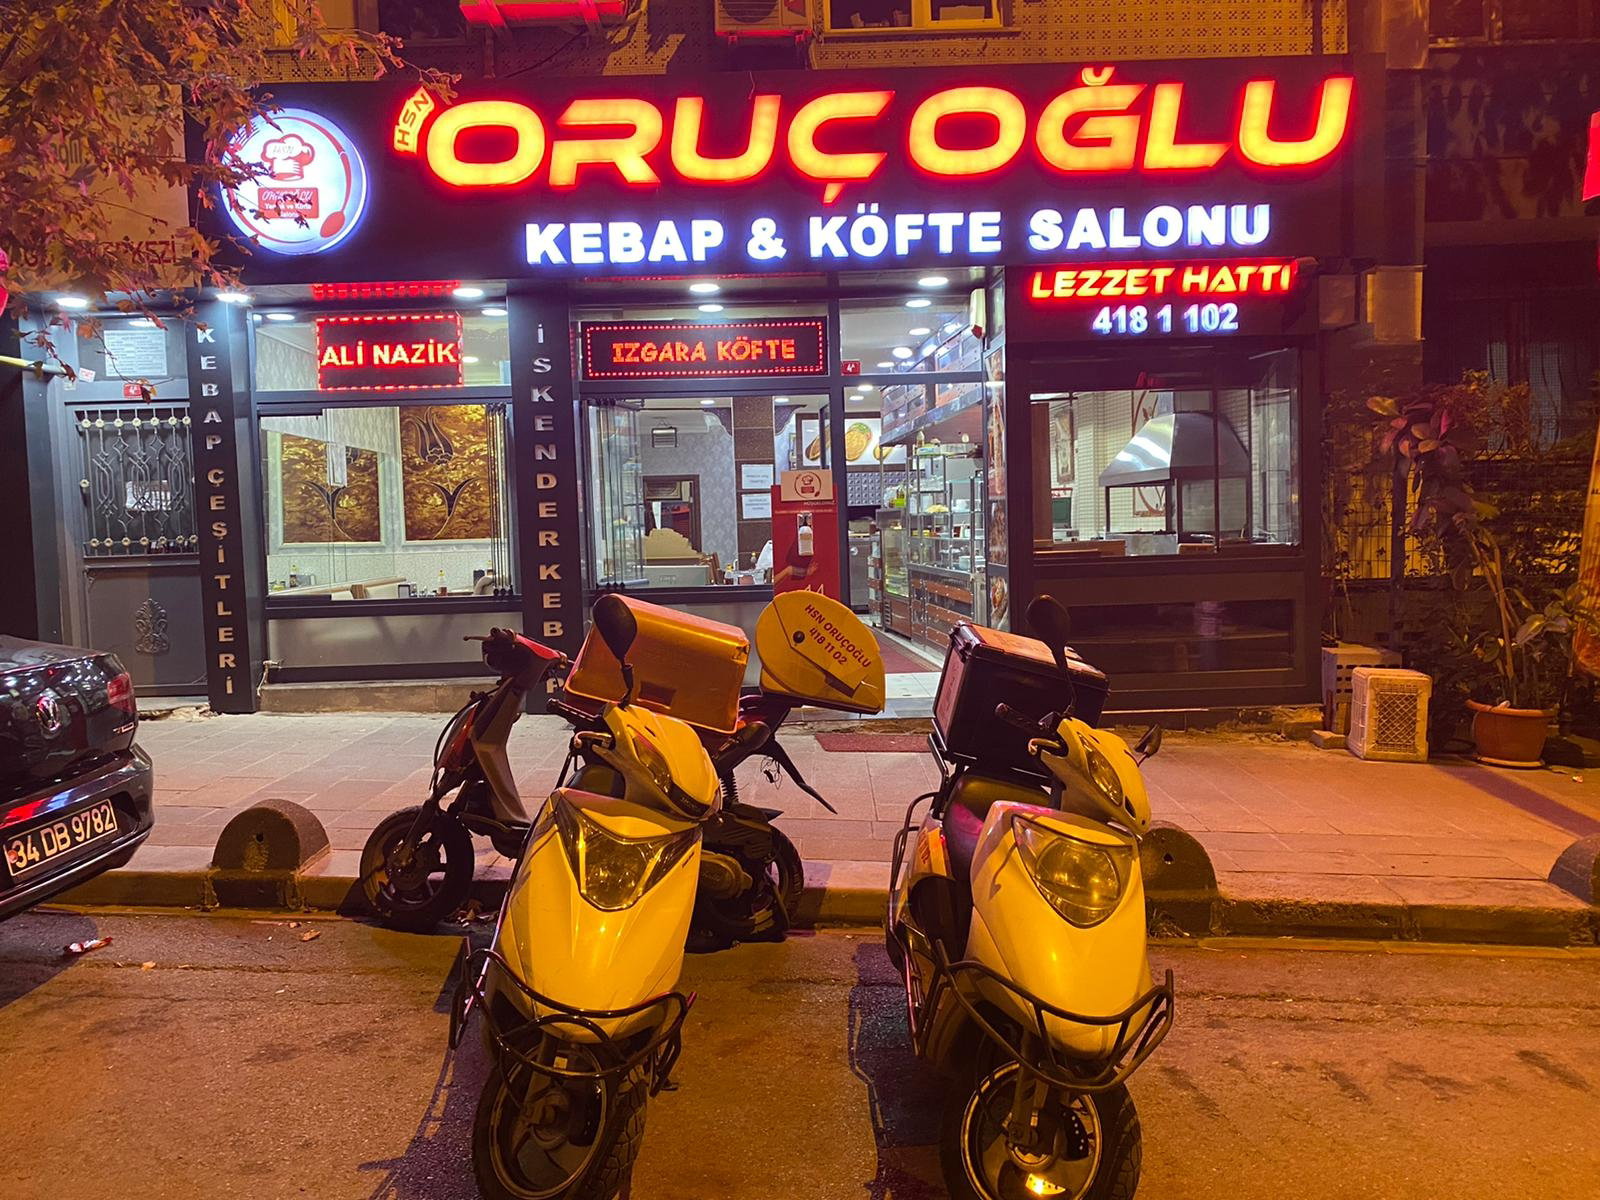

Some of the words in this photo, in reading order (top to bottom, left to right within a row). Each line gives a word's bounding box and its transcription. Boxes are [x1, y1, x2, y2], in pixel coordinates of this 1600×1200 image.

[397, 93, 429, 146] HSN
[427, 66, 1354, 203] ORUÇOĞLU
[525, 218, 725, 265] KEBAP
[746, 217, 787, 262] &
[810, 203, 1002, 258] KÖFTE
[1029, 204, 1271, 252] SALONU
[1031, 267, 1176, 299] LEZZET
[1182, 263, 1291, 295] HATTI
[612, 341, 707, 363] IZGARA
[717, 335, 795, 361] KÖFTE
[1092, 304, 1148, 334] 418
[1183, 302, 1239, 332] 102
[320, 341, 363, 366] ALİ
[373, 339, 457, 365] NAZİK
[196, 328, 222, 450] KEBAP
[530, 324, 560, 547] İSKENDER
[207, 468, 236, 694] ÇEŞİTLERİ
[539, 564, 565, 693] KEBP
[805, 604, 825, 624] HSN
[824, 622, 872, 668] ORUÇOĞLU
[809, 627, 826, 644] 418
[832, 651, 848, 665] 02
[12, 835, 40, 868] 34
[40, 822, 71, 857] DB
[71, 804, 114, 842] 9782
